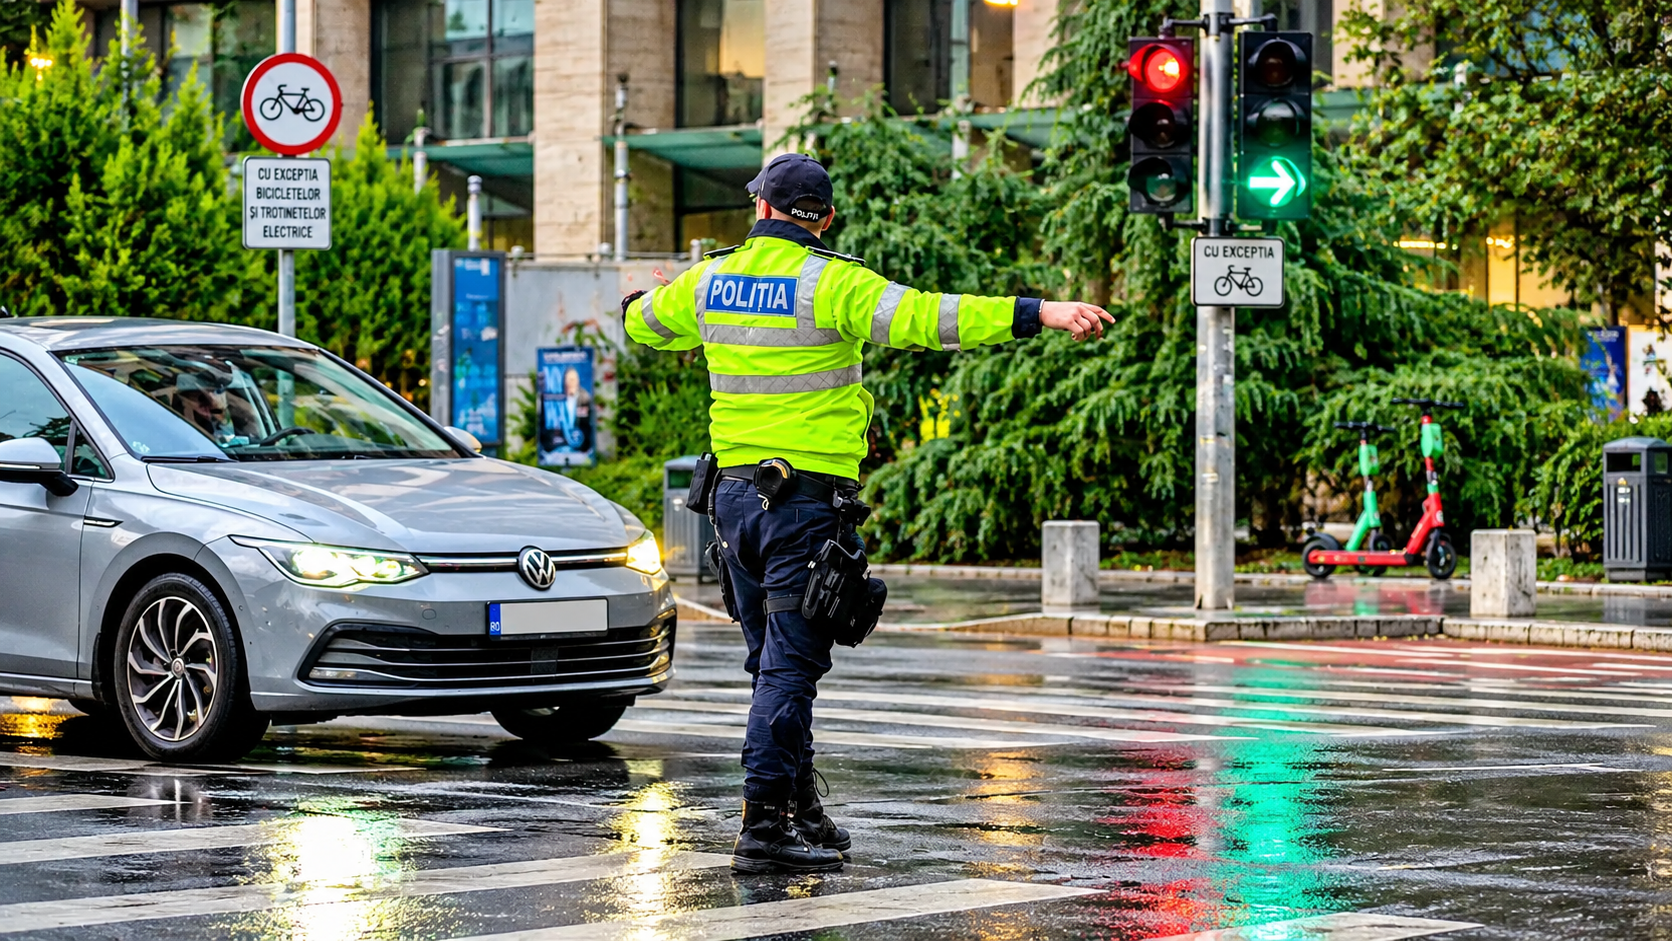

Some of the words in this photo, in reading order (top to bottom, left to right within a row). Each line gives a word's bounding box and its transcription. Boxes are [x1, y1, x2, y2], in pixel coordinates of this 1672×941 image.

[258, 167, 271, 180] CU
[274, 168, 319, 181] EXCEPTIA
[256, 187, 321, 200] BICICLETELOR
[260, 206, 326, 220] TROTINETELOR
[263, 225, 313, 238] ELECTRICE
[1204, 245, 1219, 258] CU
[1223, 246, 1275, 259] EXCEPTIA
[521, 547, 556, 589] VW
